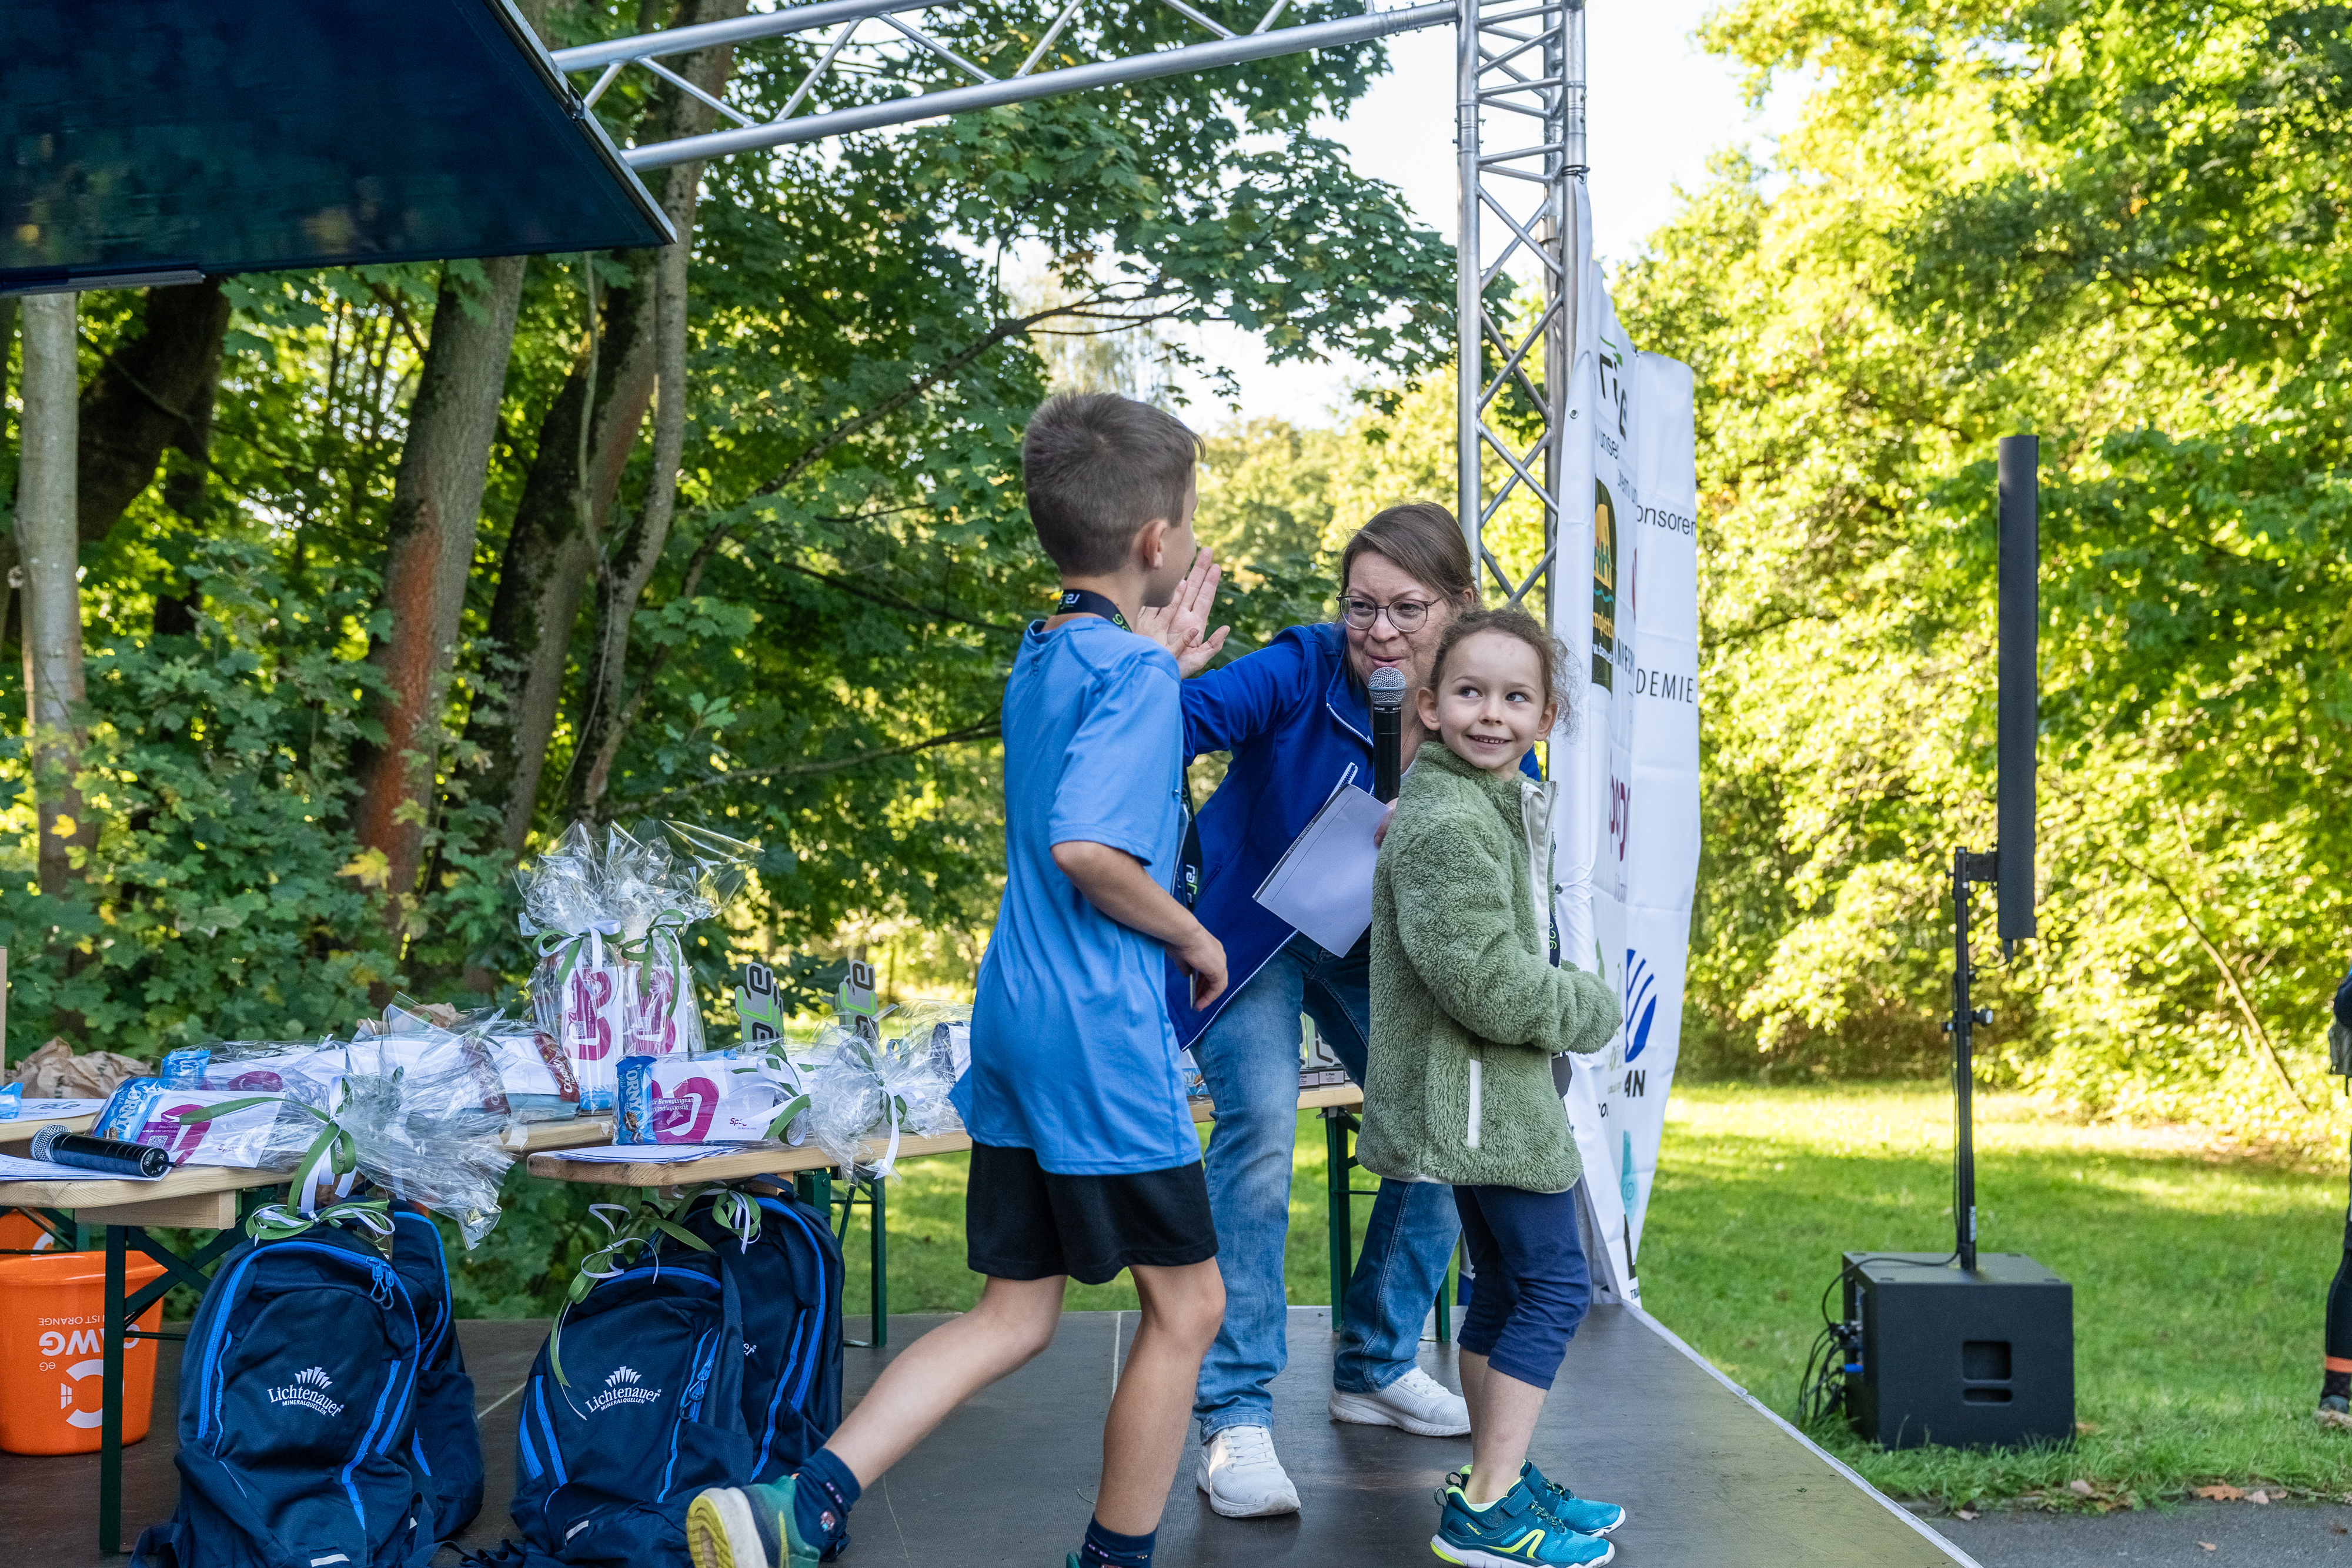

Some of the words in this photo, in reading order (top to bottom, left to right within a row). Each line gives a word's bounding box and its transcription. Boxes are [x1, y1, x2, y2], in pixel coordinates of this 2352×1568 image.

[1636, 668, 1693, 703] DEMIE
[38, 1316, 83, 1326] ORANGE
[39, 1362, 56, 1371] eG
[267, 1385, 342, 1416] Lichtenauer
[282, 1399, 327, 1415] MINERALQUELLEN
[585, 1388, 660, 1413] Lichtenauer
[600, 1398, 645, 1411] MINERALQUELLEN
